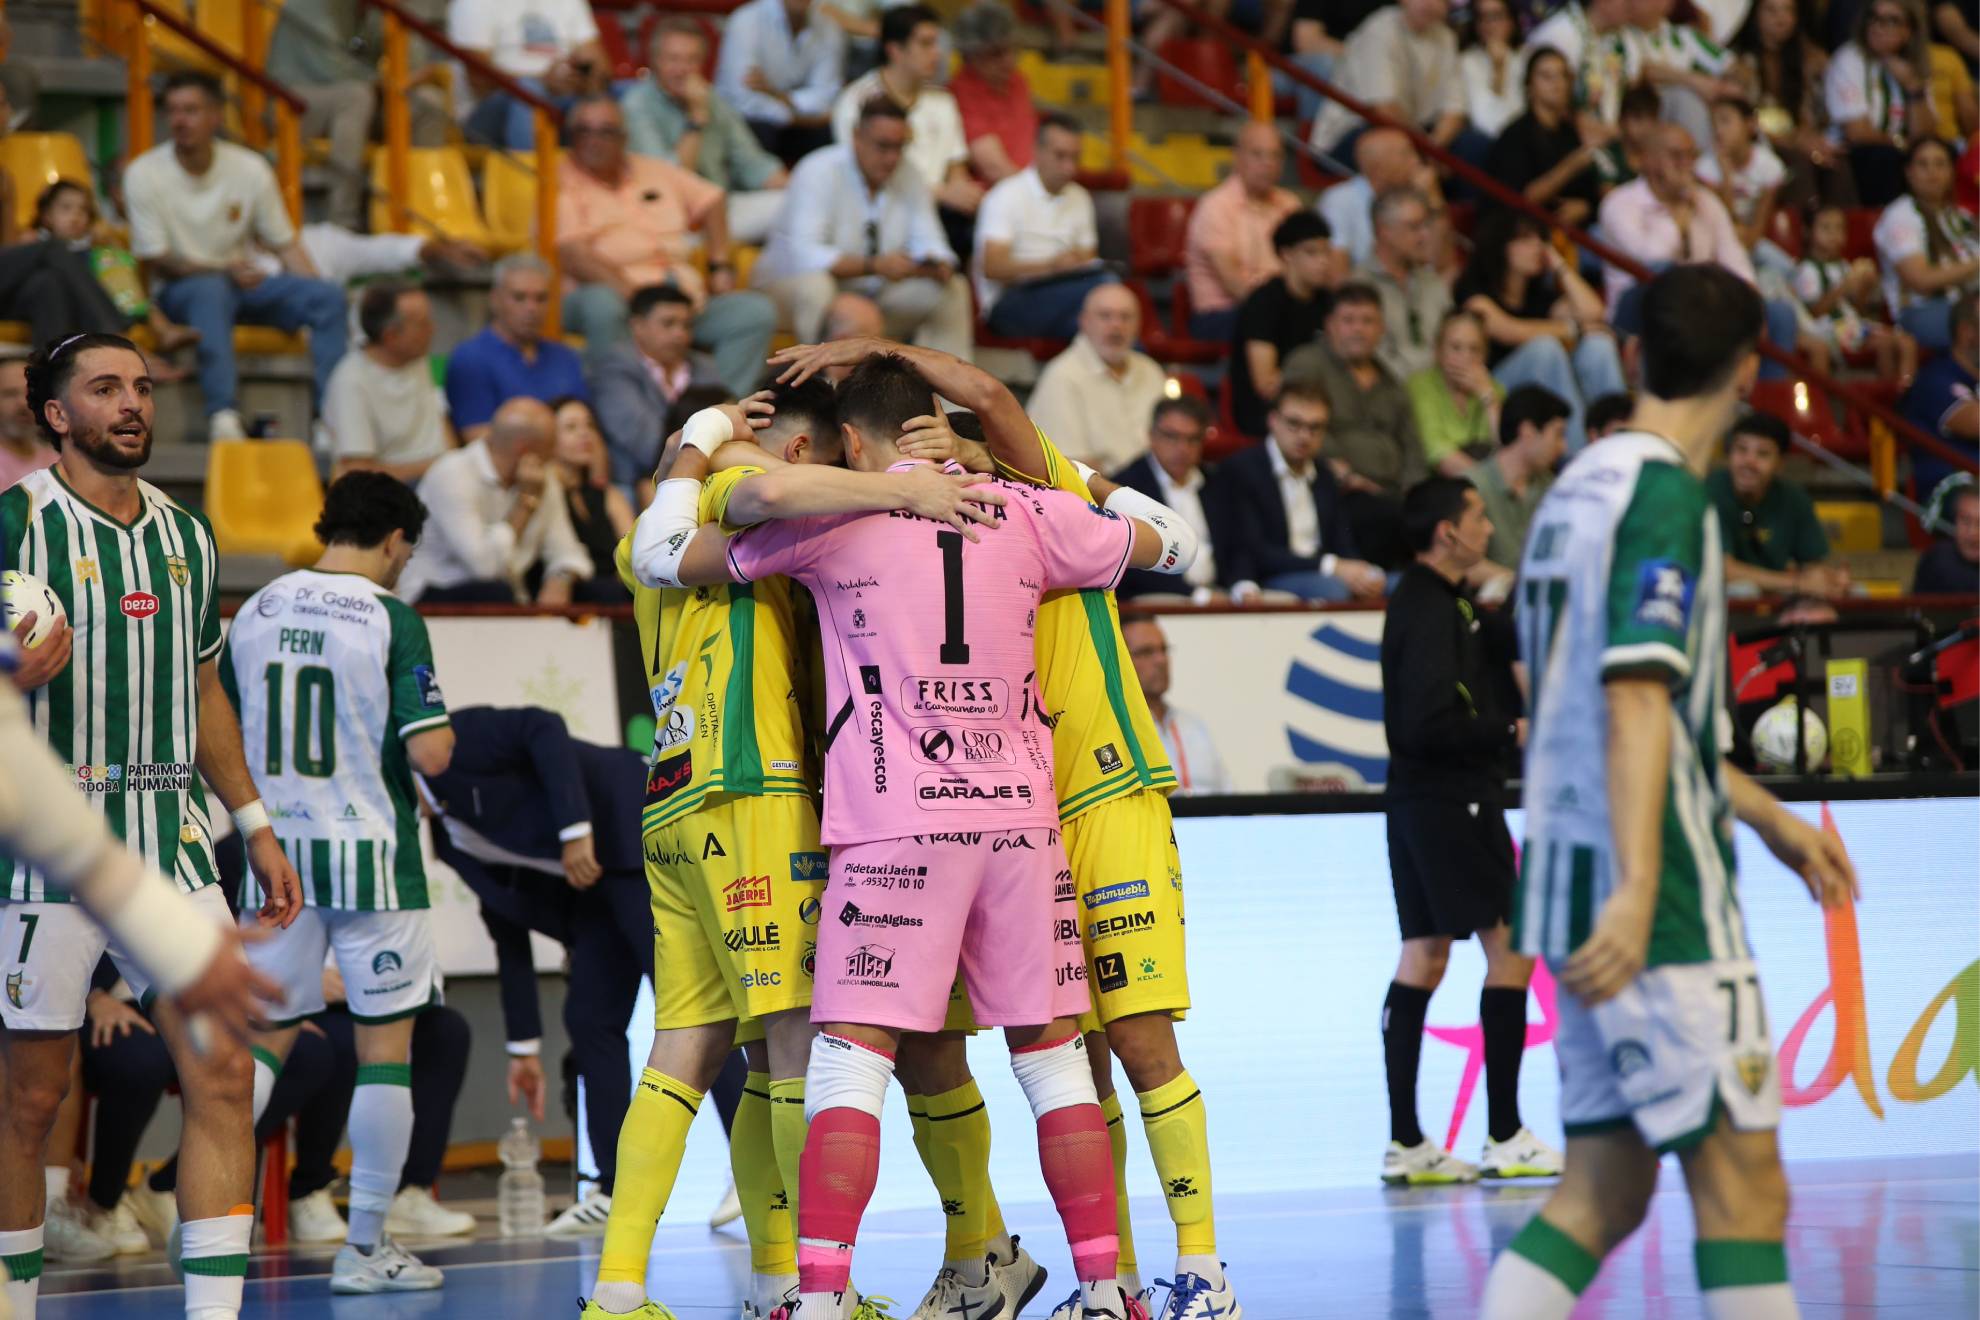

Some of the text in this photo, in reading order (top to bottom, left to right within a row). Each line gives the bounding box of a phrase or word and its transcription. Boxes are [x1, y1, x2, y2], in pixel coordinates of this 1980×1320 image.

[295, 587, 316, 601] Dr.
[937, 531, 969, 664] 1
[279, 627, 325, 656] PERIN
[918, 679, 993, 703] FRISS
[914, 701, 923, 710] de
[263, 662, 337, 779] 10
[1021, 731, 1031, 745] DE
[869, 700, 887, 794] escayescos
[128, 762, 190, 777] PATRIMON
[73, 781, 120, 792] RDOBA
[702, 832, 726, 860] A
[888, 864, 916, 877] Jaén
[898, 877, 910, 889] 10
[913, 878, 925, 890] 10
[854, 910, 924, 928] EuroAlglass
[20, 914, 39, 963] 7
[1099, 958, 1119, 980] LZ
[1137, 972, 1164, 982] KELME
[837, 978, 860, 986] AGENCIA
